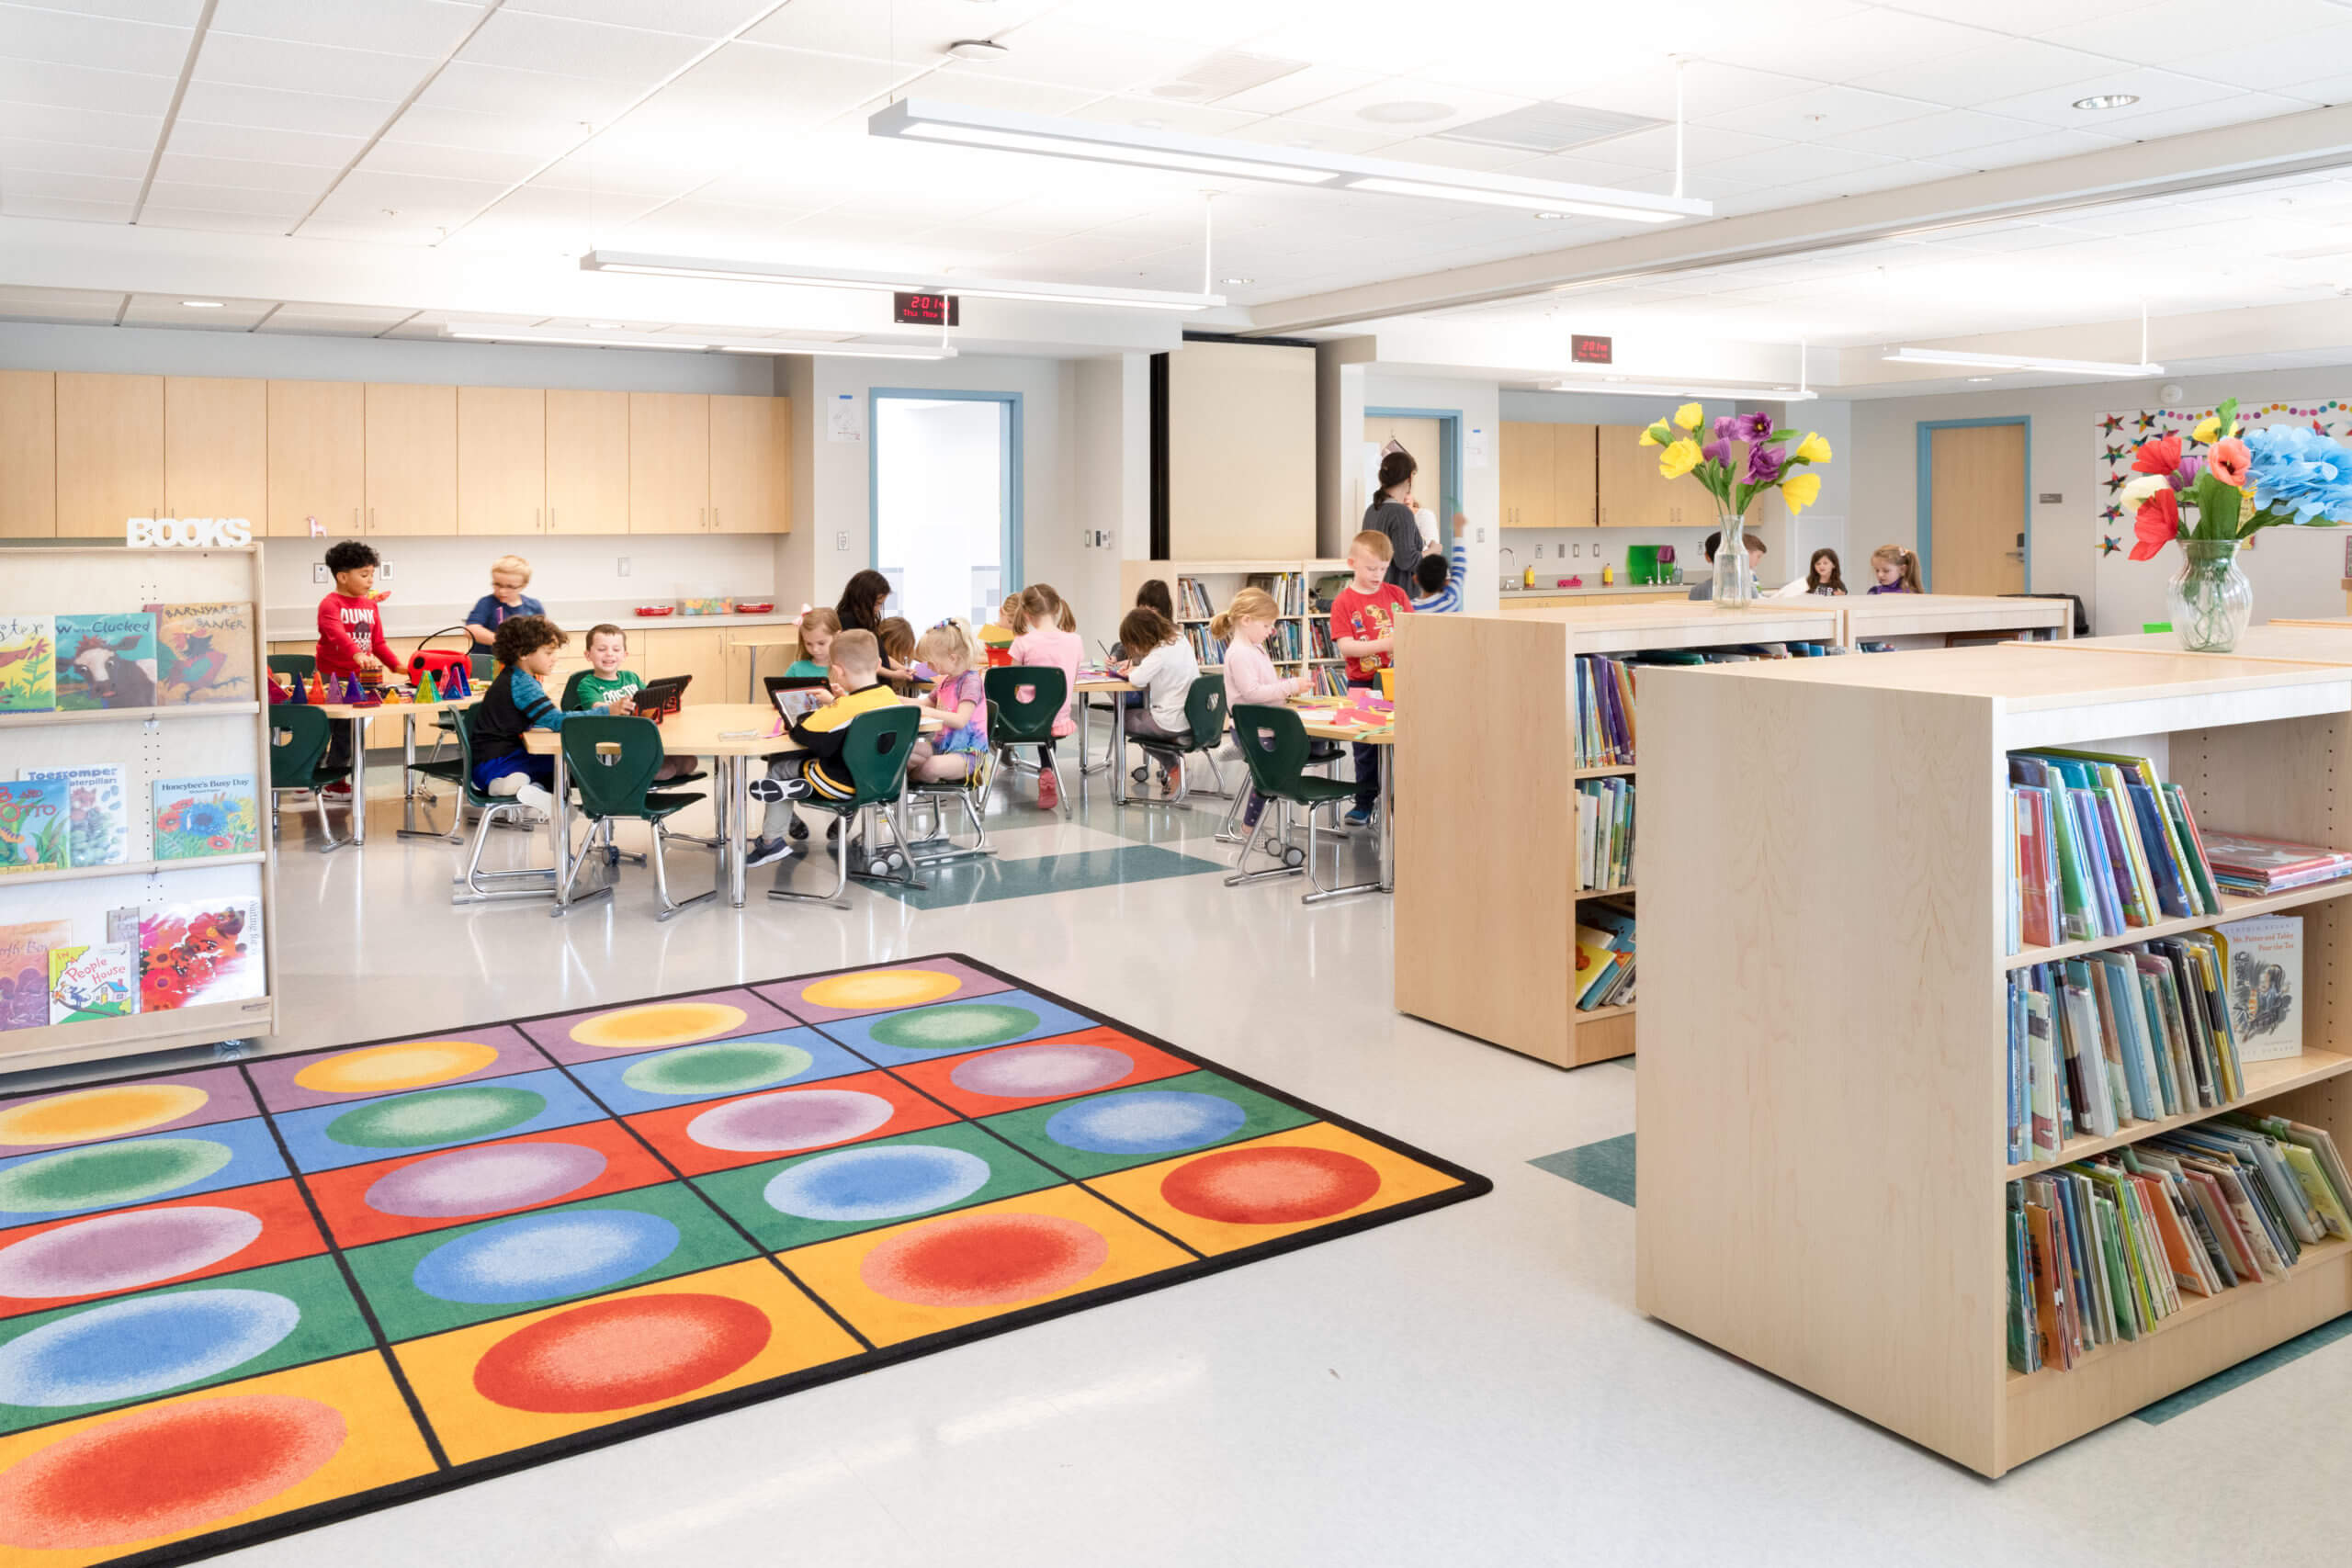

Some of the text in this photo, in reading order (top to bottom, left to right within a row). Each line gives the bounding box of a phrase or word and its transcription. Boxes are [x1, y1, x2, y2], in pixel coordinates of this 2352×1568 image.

[127, 517, 252, 547] BOOKS
[341, 607, 375, 625] DUNK
[93, 621, 150, 633] Clucked
[162, 782, 208, 791] Honeybee's
[64, 957, 107, 983] People
[92, 964, 126, 984] House
